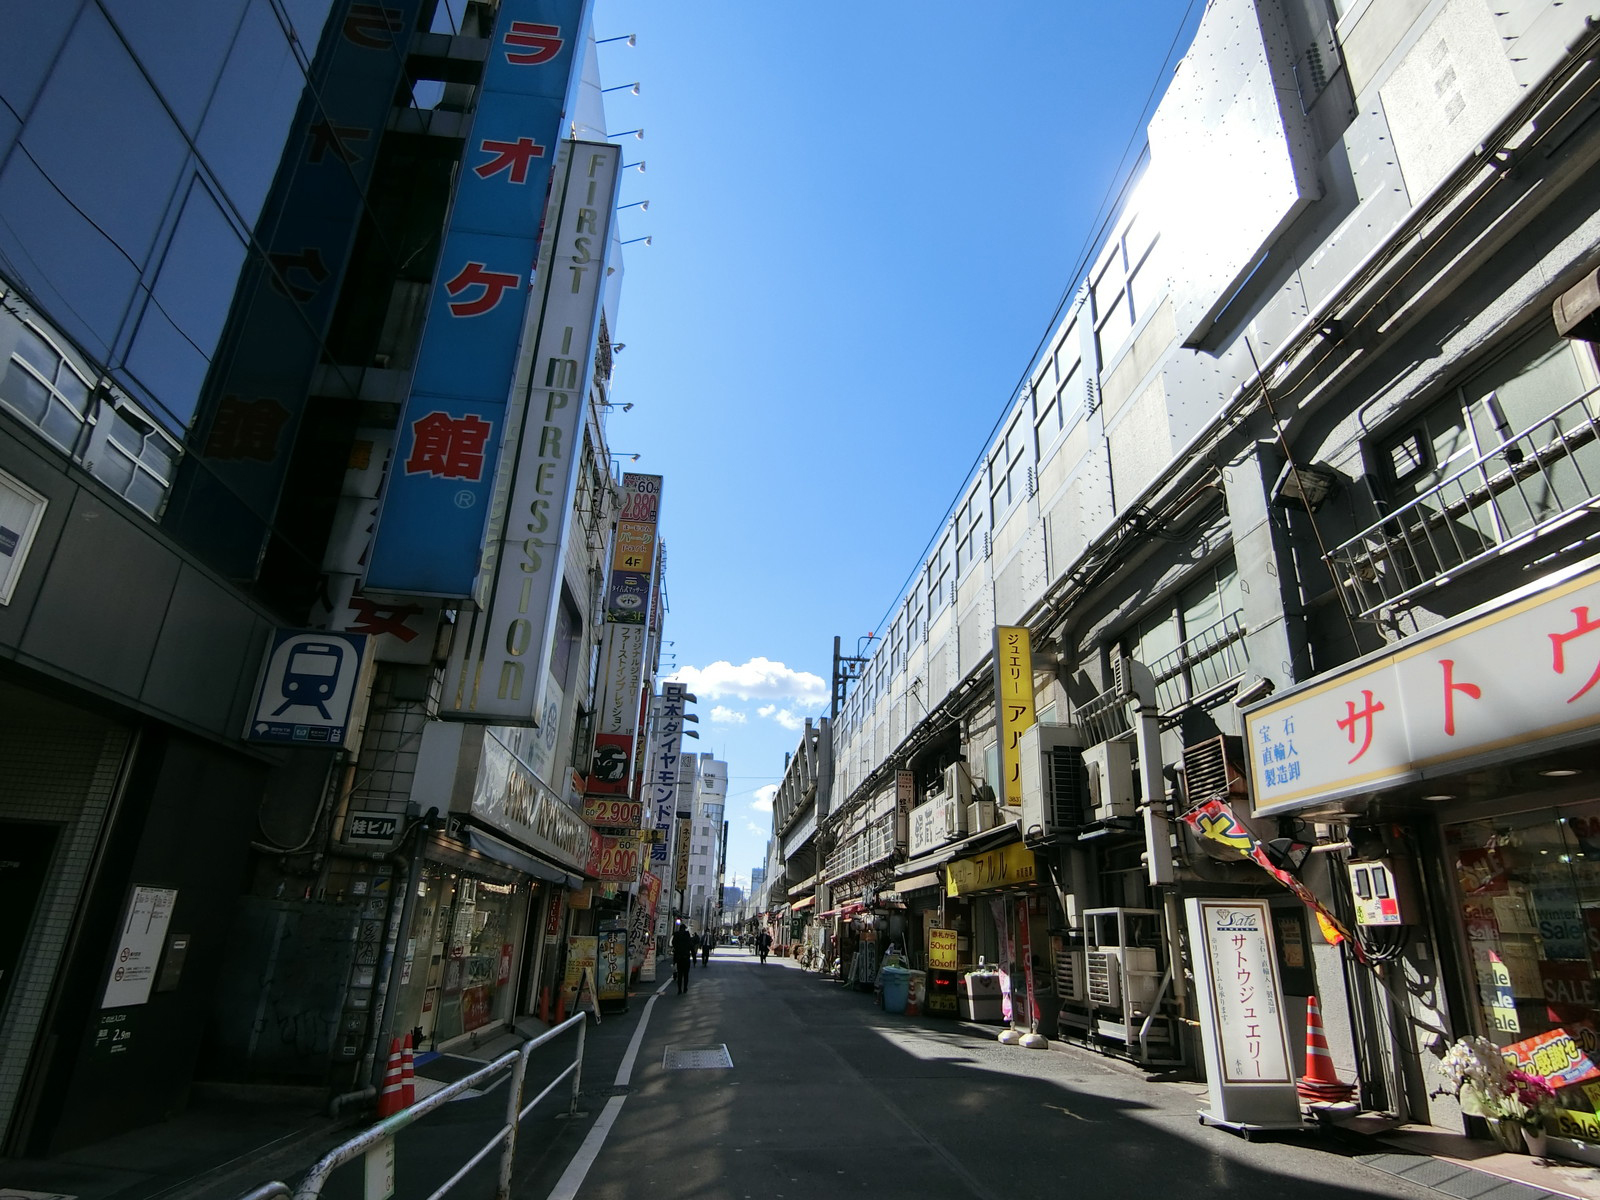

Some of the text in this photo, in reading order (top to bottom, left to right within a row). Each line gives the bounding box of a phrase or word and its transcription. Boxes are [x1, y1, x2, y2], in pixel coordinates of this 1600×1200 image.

[569, 153, 607, 294] FIRST
[619, 533, 652, 544] パーク
[625, 556, 642, 567] 4F
[1008, 634, 1021, 694] ジュエリー
[611, 627, 630, 733] ファーストインプレッション
[1262, 739, 1298, 766] 直輸入
[1264, 761, 1302, 788] 製造卸
[352, 819, 396, 835] 桂ビル
[976, 852, 1007, 885] アルル
[1540, 920, 1581, 940] Sale
[930, 941, 956, 951] 50%off
[930, 958, 956, 968] 20%off
[1482, 990, 1515, 1008] Sale
[1543, 978, 1596, 1004] SALE
[1231, 933, 1262, 1078] サトウジュエリー
[1486, 1013, 1518, 1031] Sale
[112, 1028, 132, 1042] 2.9m
